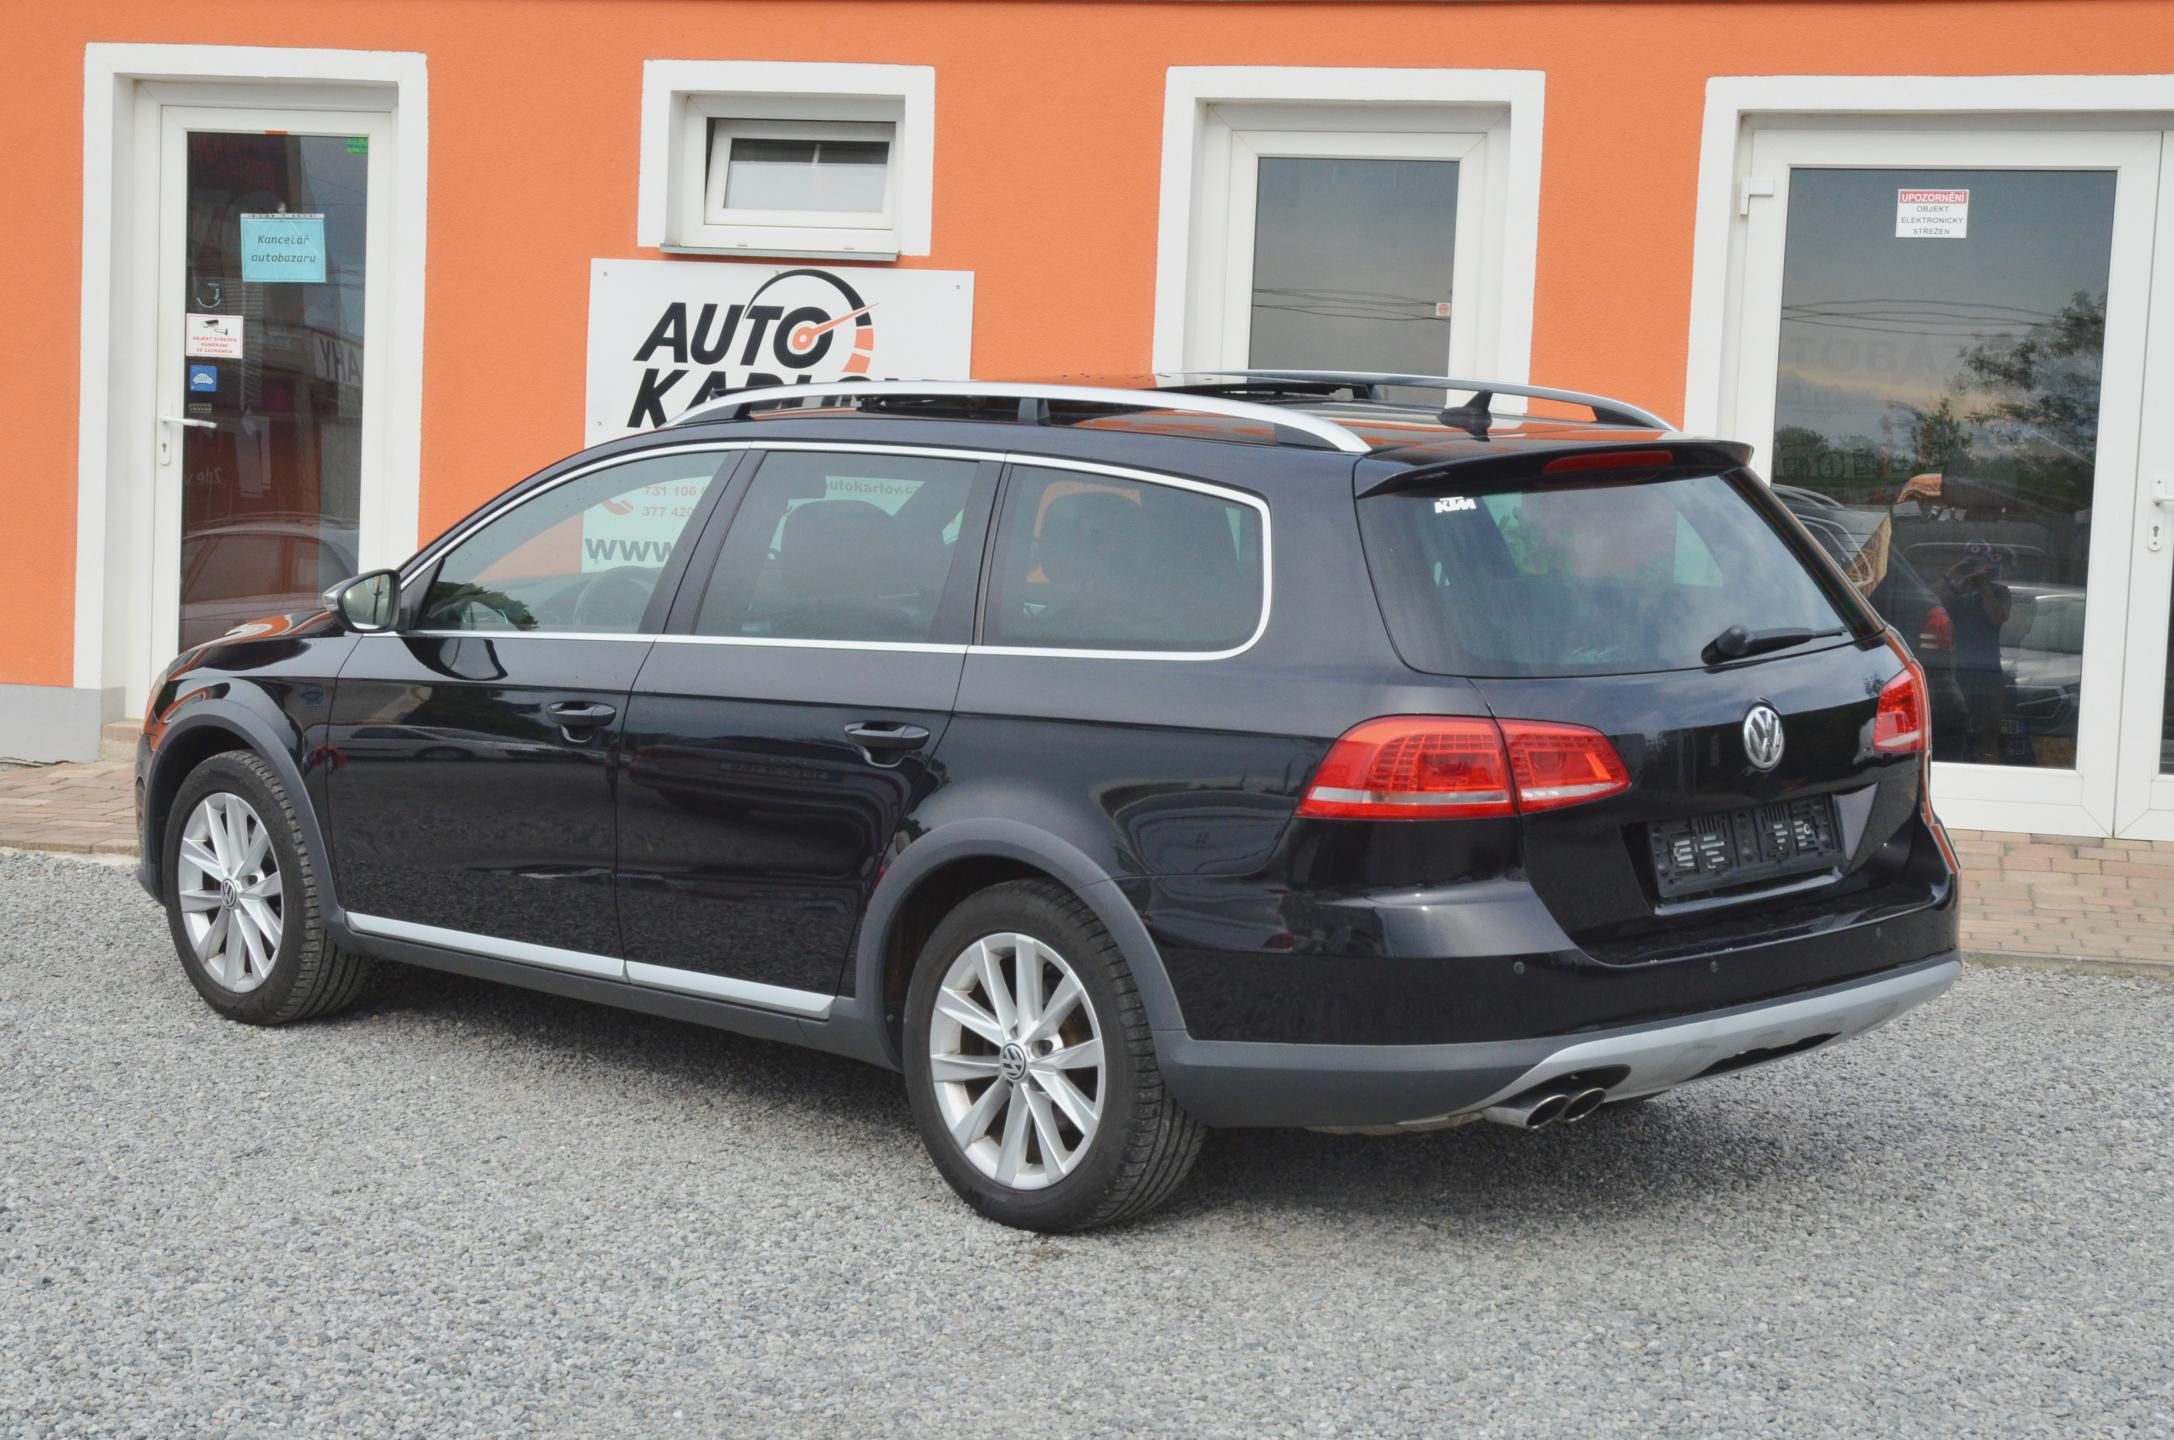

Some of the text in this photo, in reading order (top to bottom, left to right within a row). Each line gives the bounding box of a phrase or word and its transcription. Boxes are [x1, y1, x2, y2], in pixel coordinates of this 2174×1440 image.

[1916, 205, 1949, 213] OBJEKT
[251, 253, 316, 263] autobazaru
[632, 301, 834, 370] AUTO
[643, 485, 667, 497] 731
[673, 485, 697, 497] 106
[642, 505, 667, 517] 377
